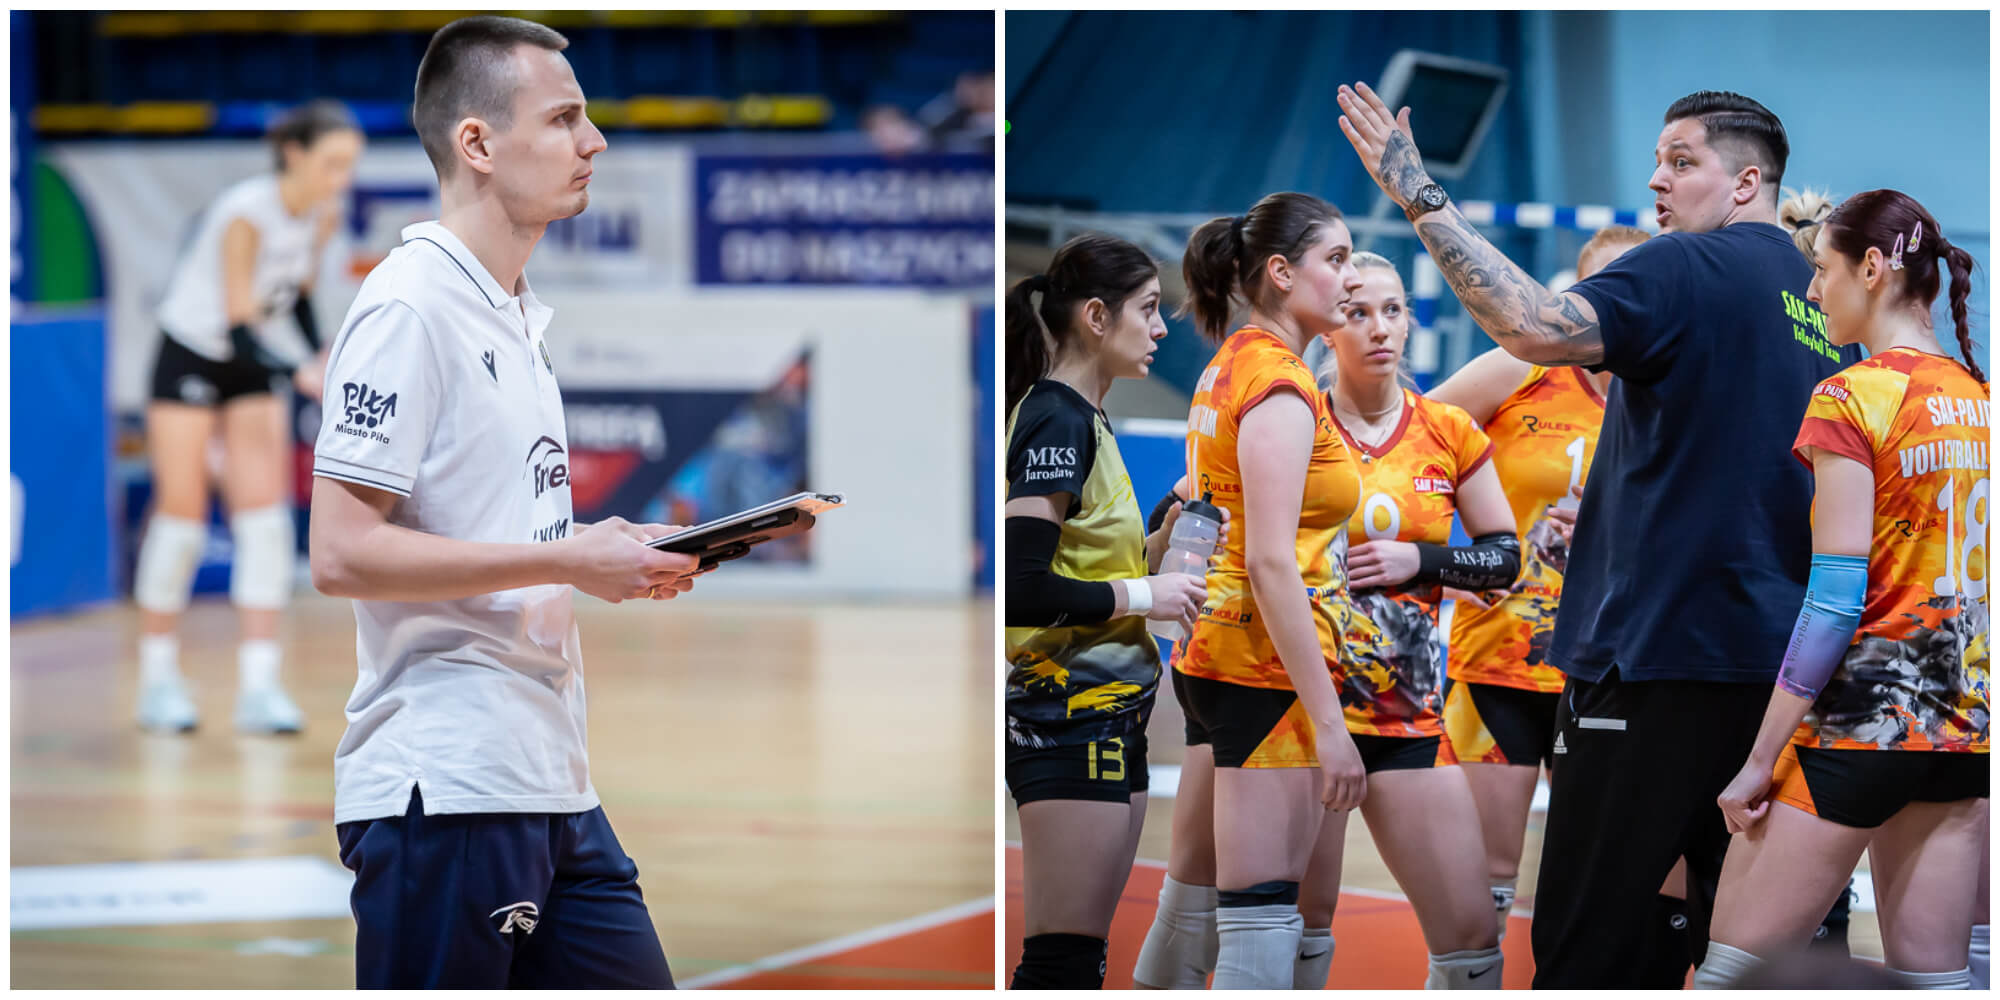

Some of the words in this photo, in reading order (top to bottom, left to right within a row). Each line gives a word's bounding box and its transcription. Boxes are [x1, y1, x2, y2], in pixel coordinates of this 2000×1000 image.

[1824, 341, 1841, 364] Team
[1824, 384, 1849, 402] PAJDA
[335, 423, 368, 439] Miasto
[1026, 446, 1077, 468] MKS
[1899, 439, 1988, 479] VOLLEYBALL
[1934, 473, 1990, 599] 18
[1088, 736, 1125, 781] 13
